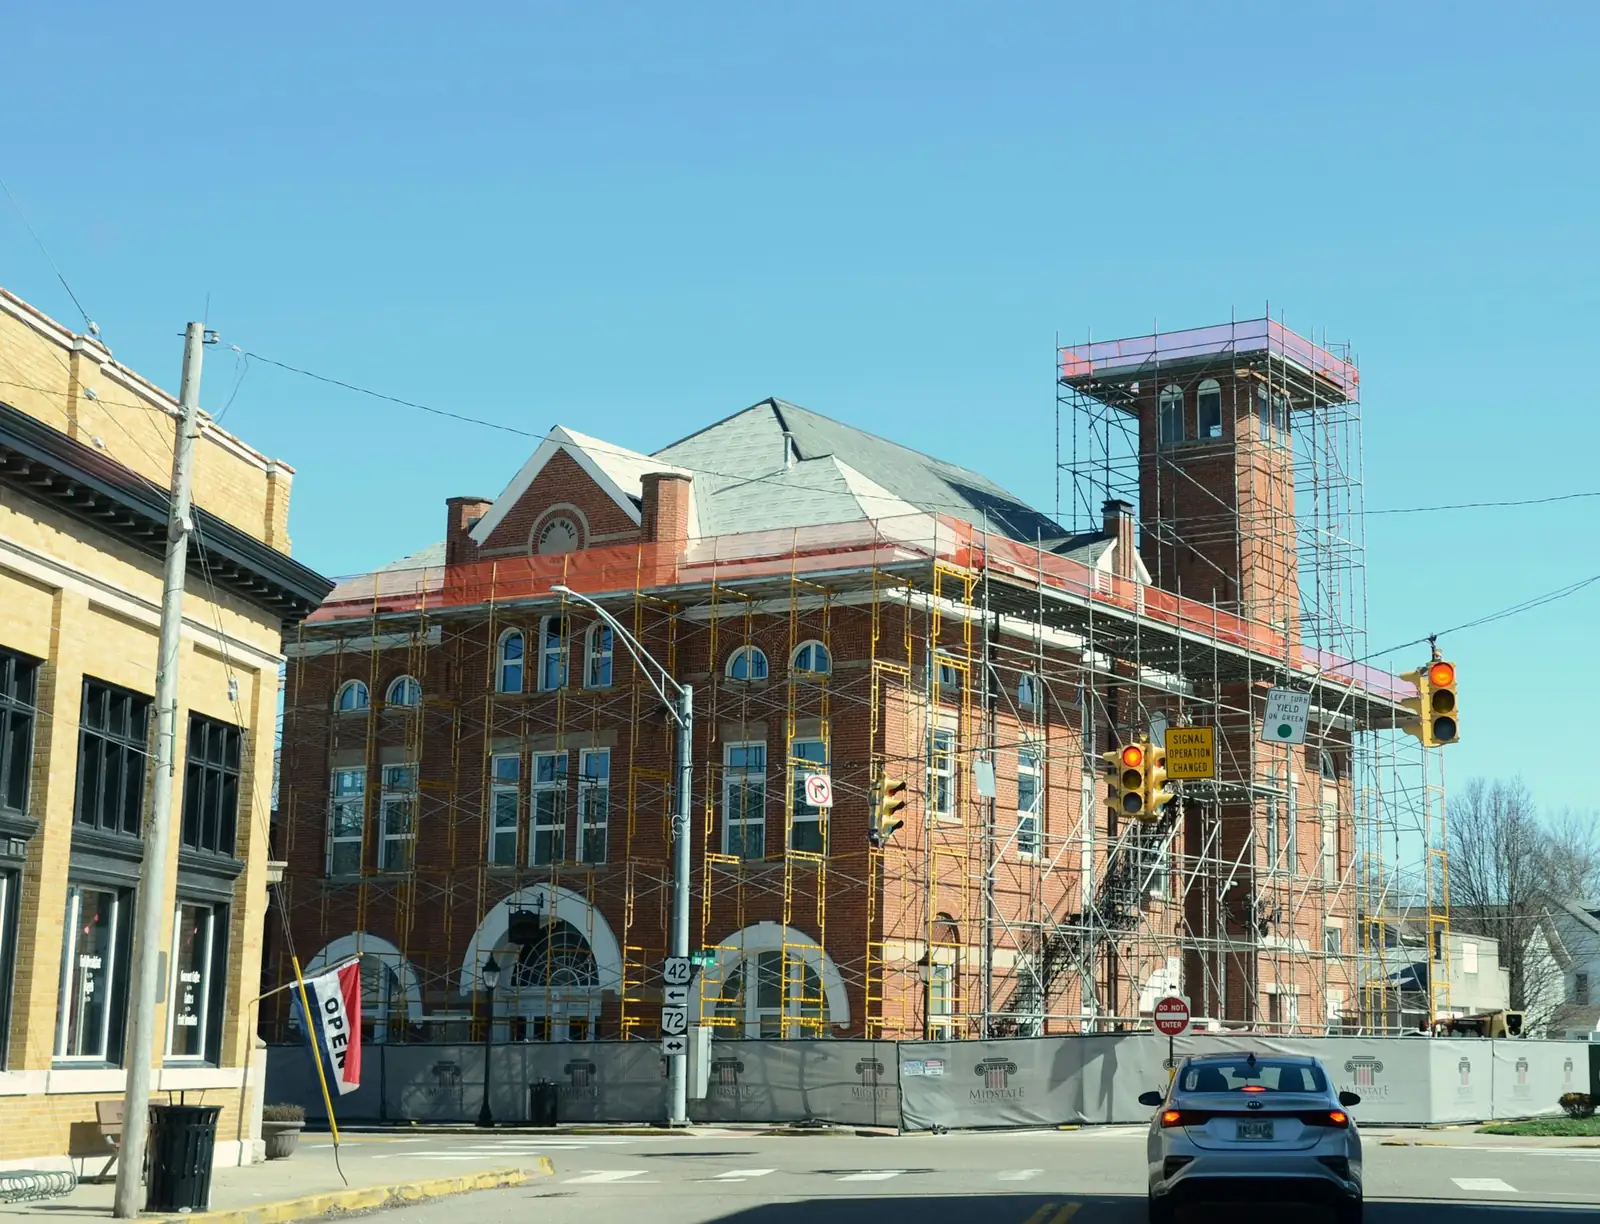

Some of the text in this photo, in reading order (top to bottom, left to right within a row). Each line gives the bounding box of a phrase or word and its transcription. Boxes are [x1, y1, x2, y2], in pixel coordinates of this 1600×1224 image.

[540, 519, 575, 545] TOWN HALL
[1270, 693, 1308, 704] LEFT TURN
[1277, 703, 1299, 713] YIELD
[1281, 714, 1304, 722] GREEN
[1173, 733, 1206, 744] SIGNAL
[1169, 747, 1211, 758] OPERATION
[1173, 762, 1208, 773] CHANGED
[668, 963, 686, 979] 42
[1159, 1004, 1184, 1012] DO NOT
[664, 1012, 684, 1029] 72
[1161, 1021, 1182, 1029] ENTER
[324, 997, 349, 1070] OPEN
[969, 1086, 1025, 1100] MIDSTATE
